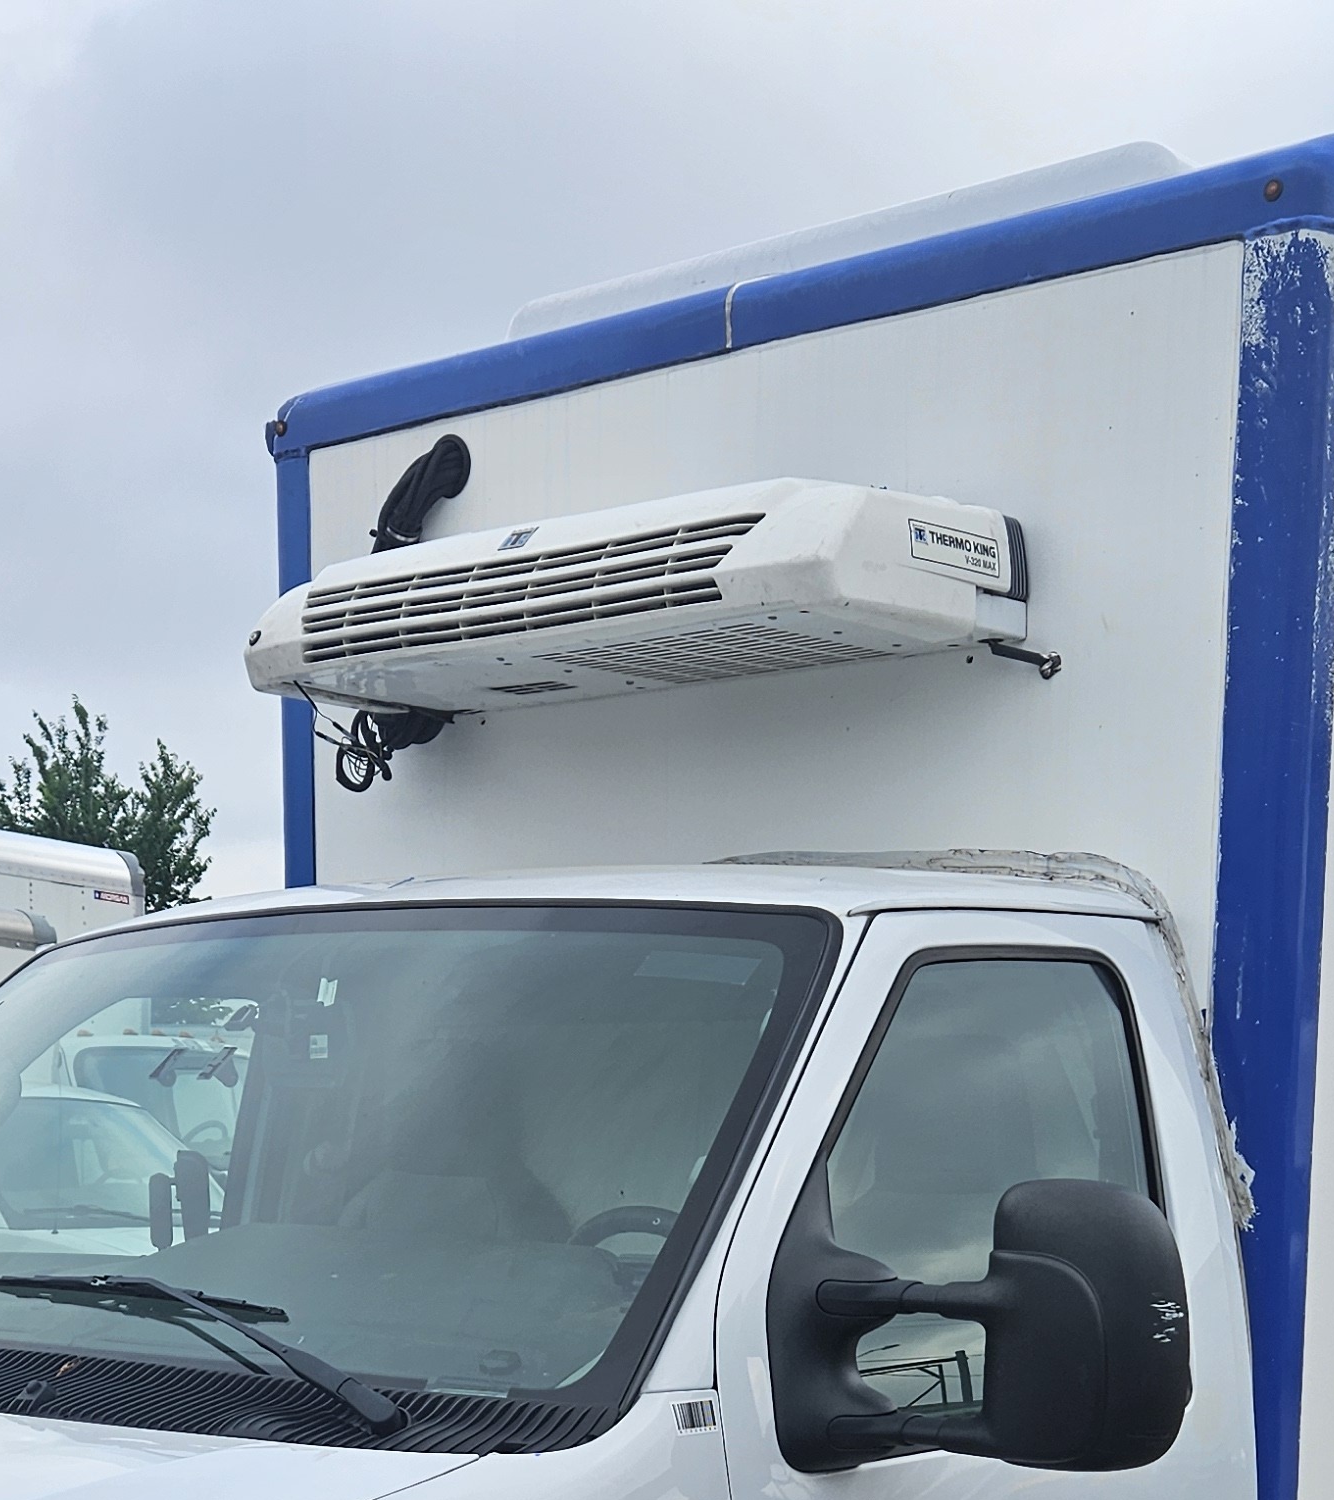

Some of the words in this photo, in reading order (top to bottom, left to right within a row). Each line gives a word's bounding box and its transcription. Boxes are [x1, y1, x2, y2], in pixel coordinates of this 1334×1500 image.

[928, 530, 972, 552] THERMO
[973, 541, 996, 558] KING
[965, 555, 982, 567] V-320
[982, 559, 997, 571] MAX
